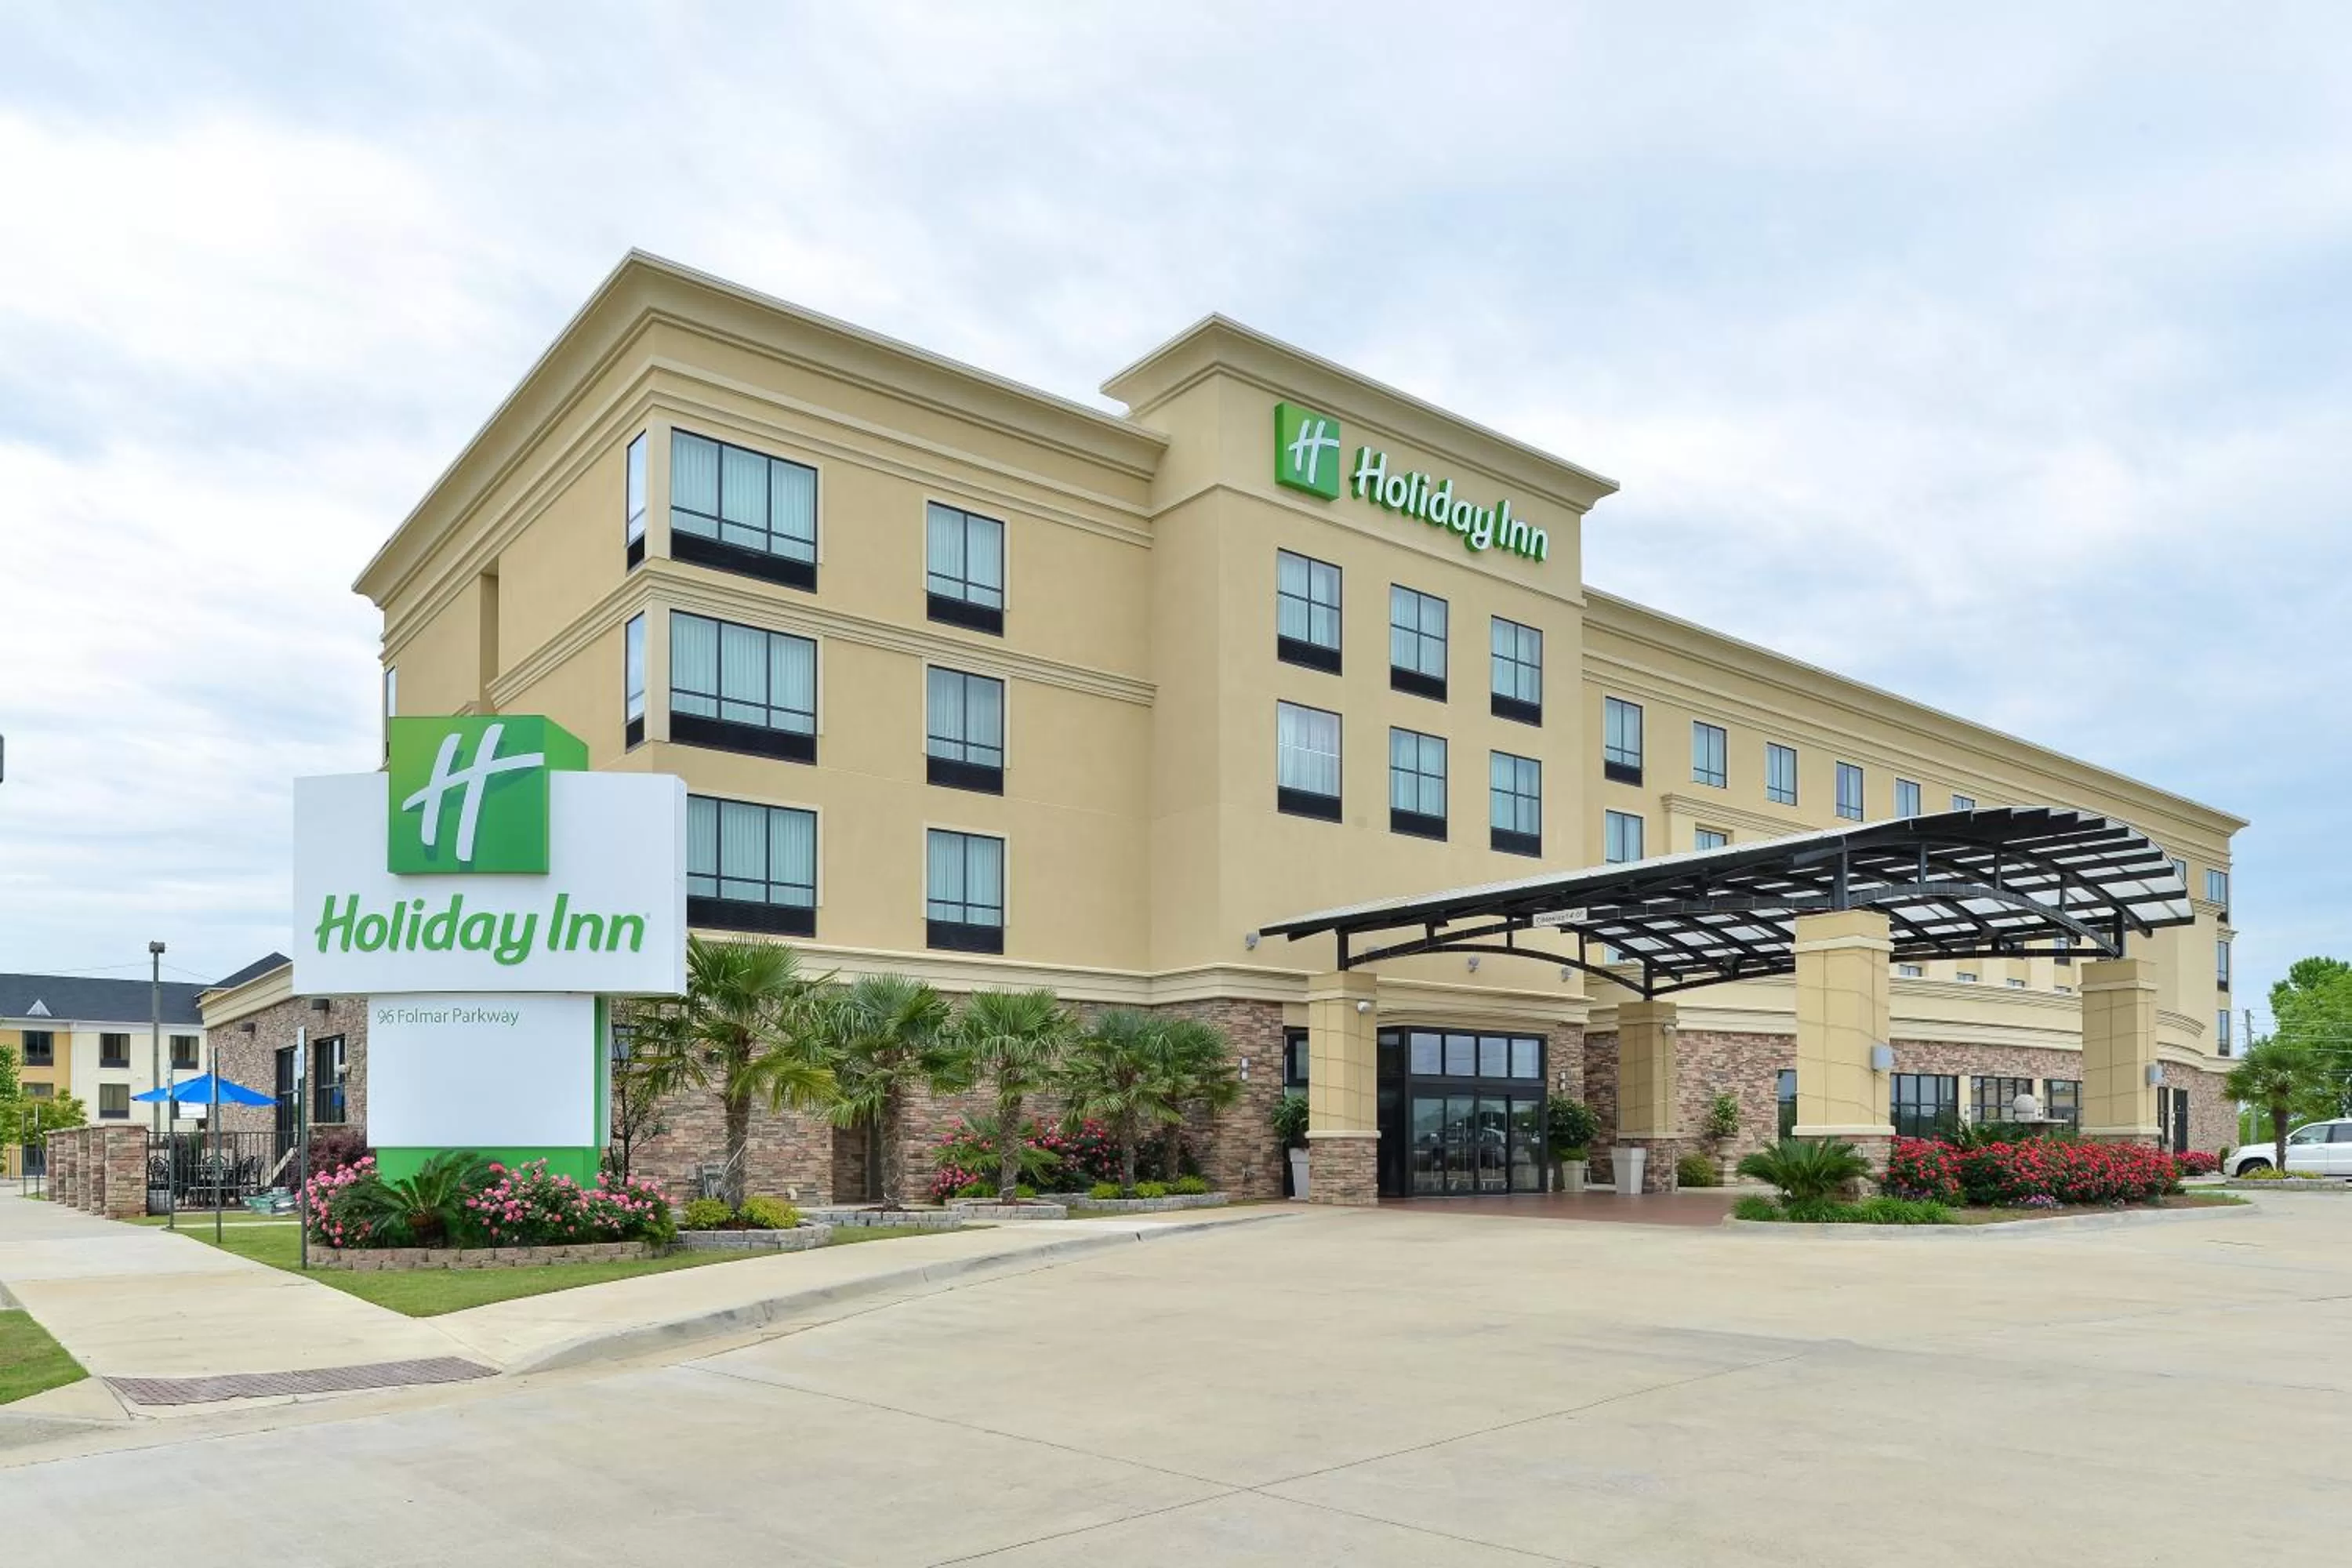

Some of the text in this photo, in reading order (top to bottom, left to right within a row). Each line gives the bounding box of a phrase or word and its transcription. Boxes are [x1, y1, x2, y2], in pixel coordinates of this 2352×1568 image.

[1352, 446, 1548, 562] Holiday Inn
[314, 893, 646, 966] Holiday Inn
[377, 1007, 520, 1026] 96 Folmar Parkway
